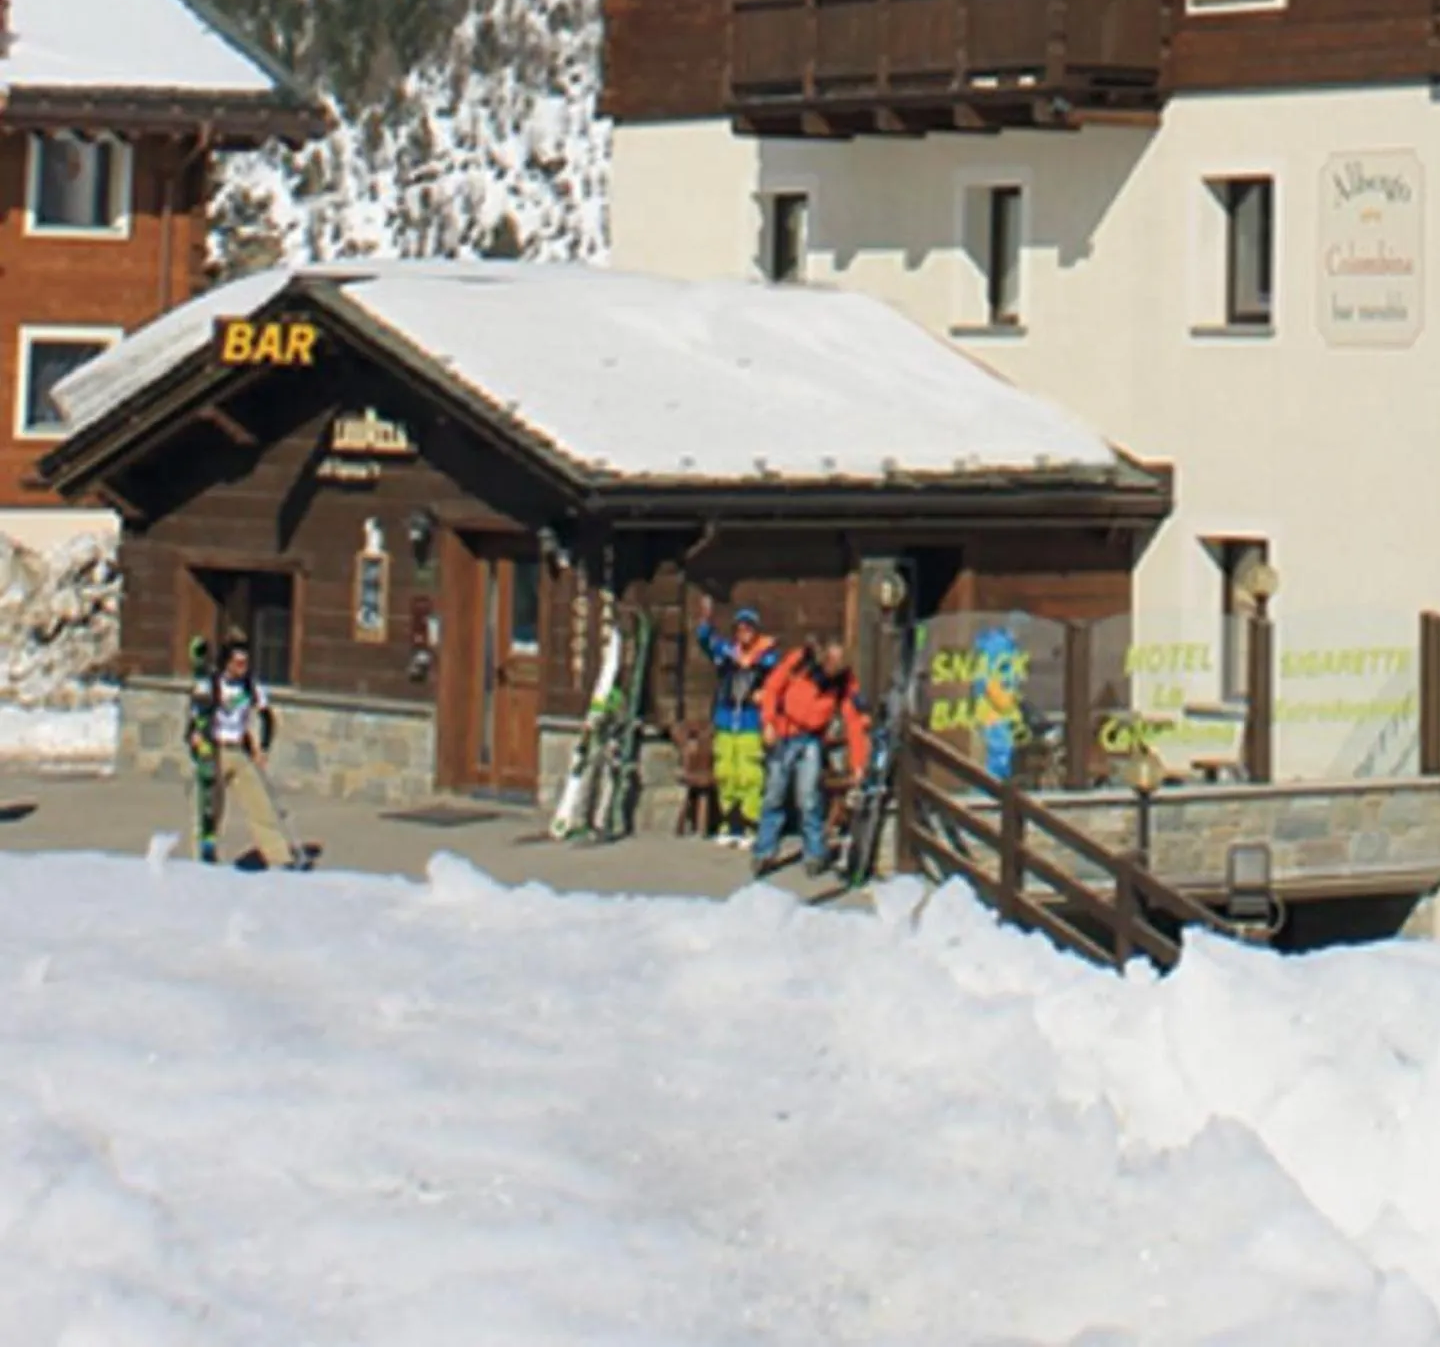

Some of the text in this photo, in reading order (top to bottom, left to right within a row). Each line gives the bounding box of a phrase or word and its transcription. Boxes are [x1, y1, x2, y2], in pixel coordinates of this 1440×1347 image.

[223, 322, 316, 363] BAR
[930, 651, 1030, 684] SNACK
[1123, 642, 1213, 677] HOTEL
